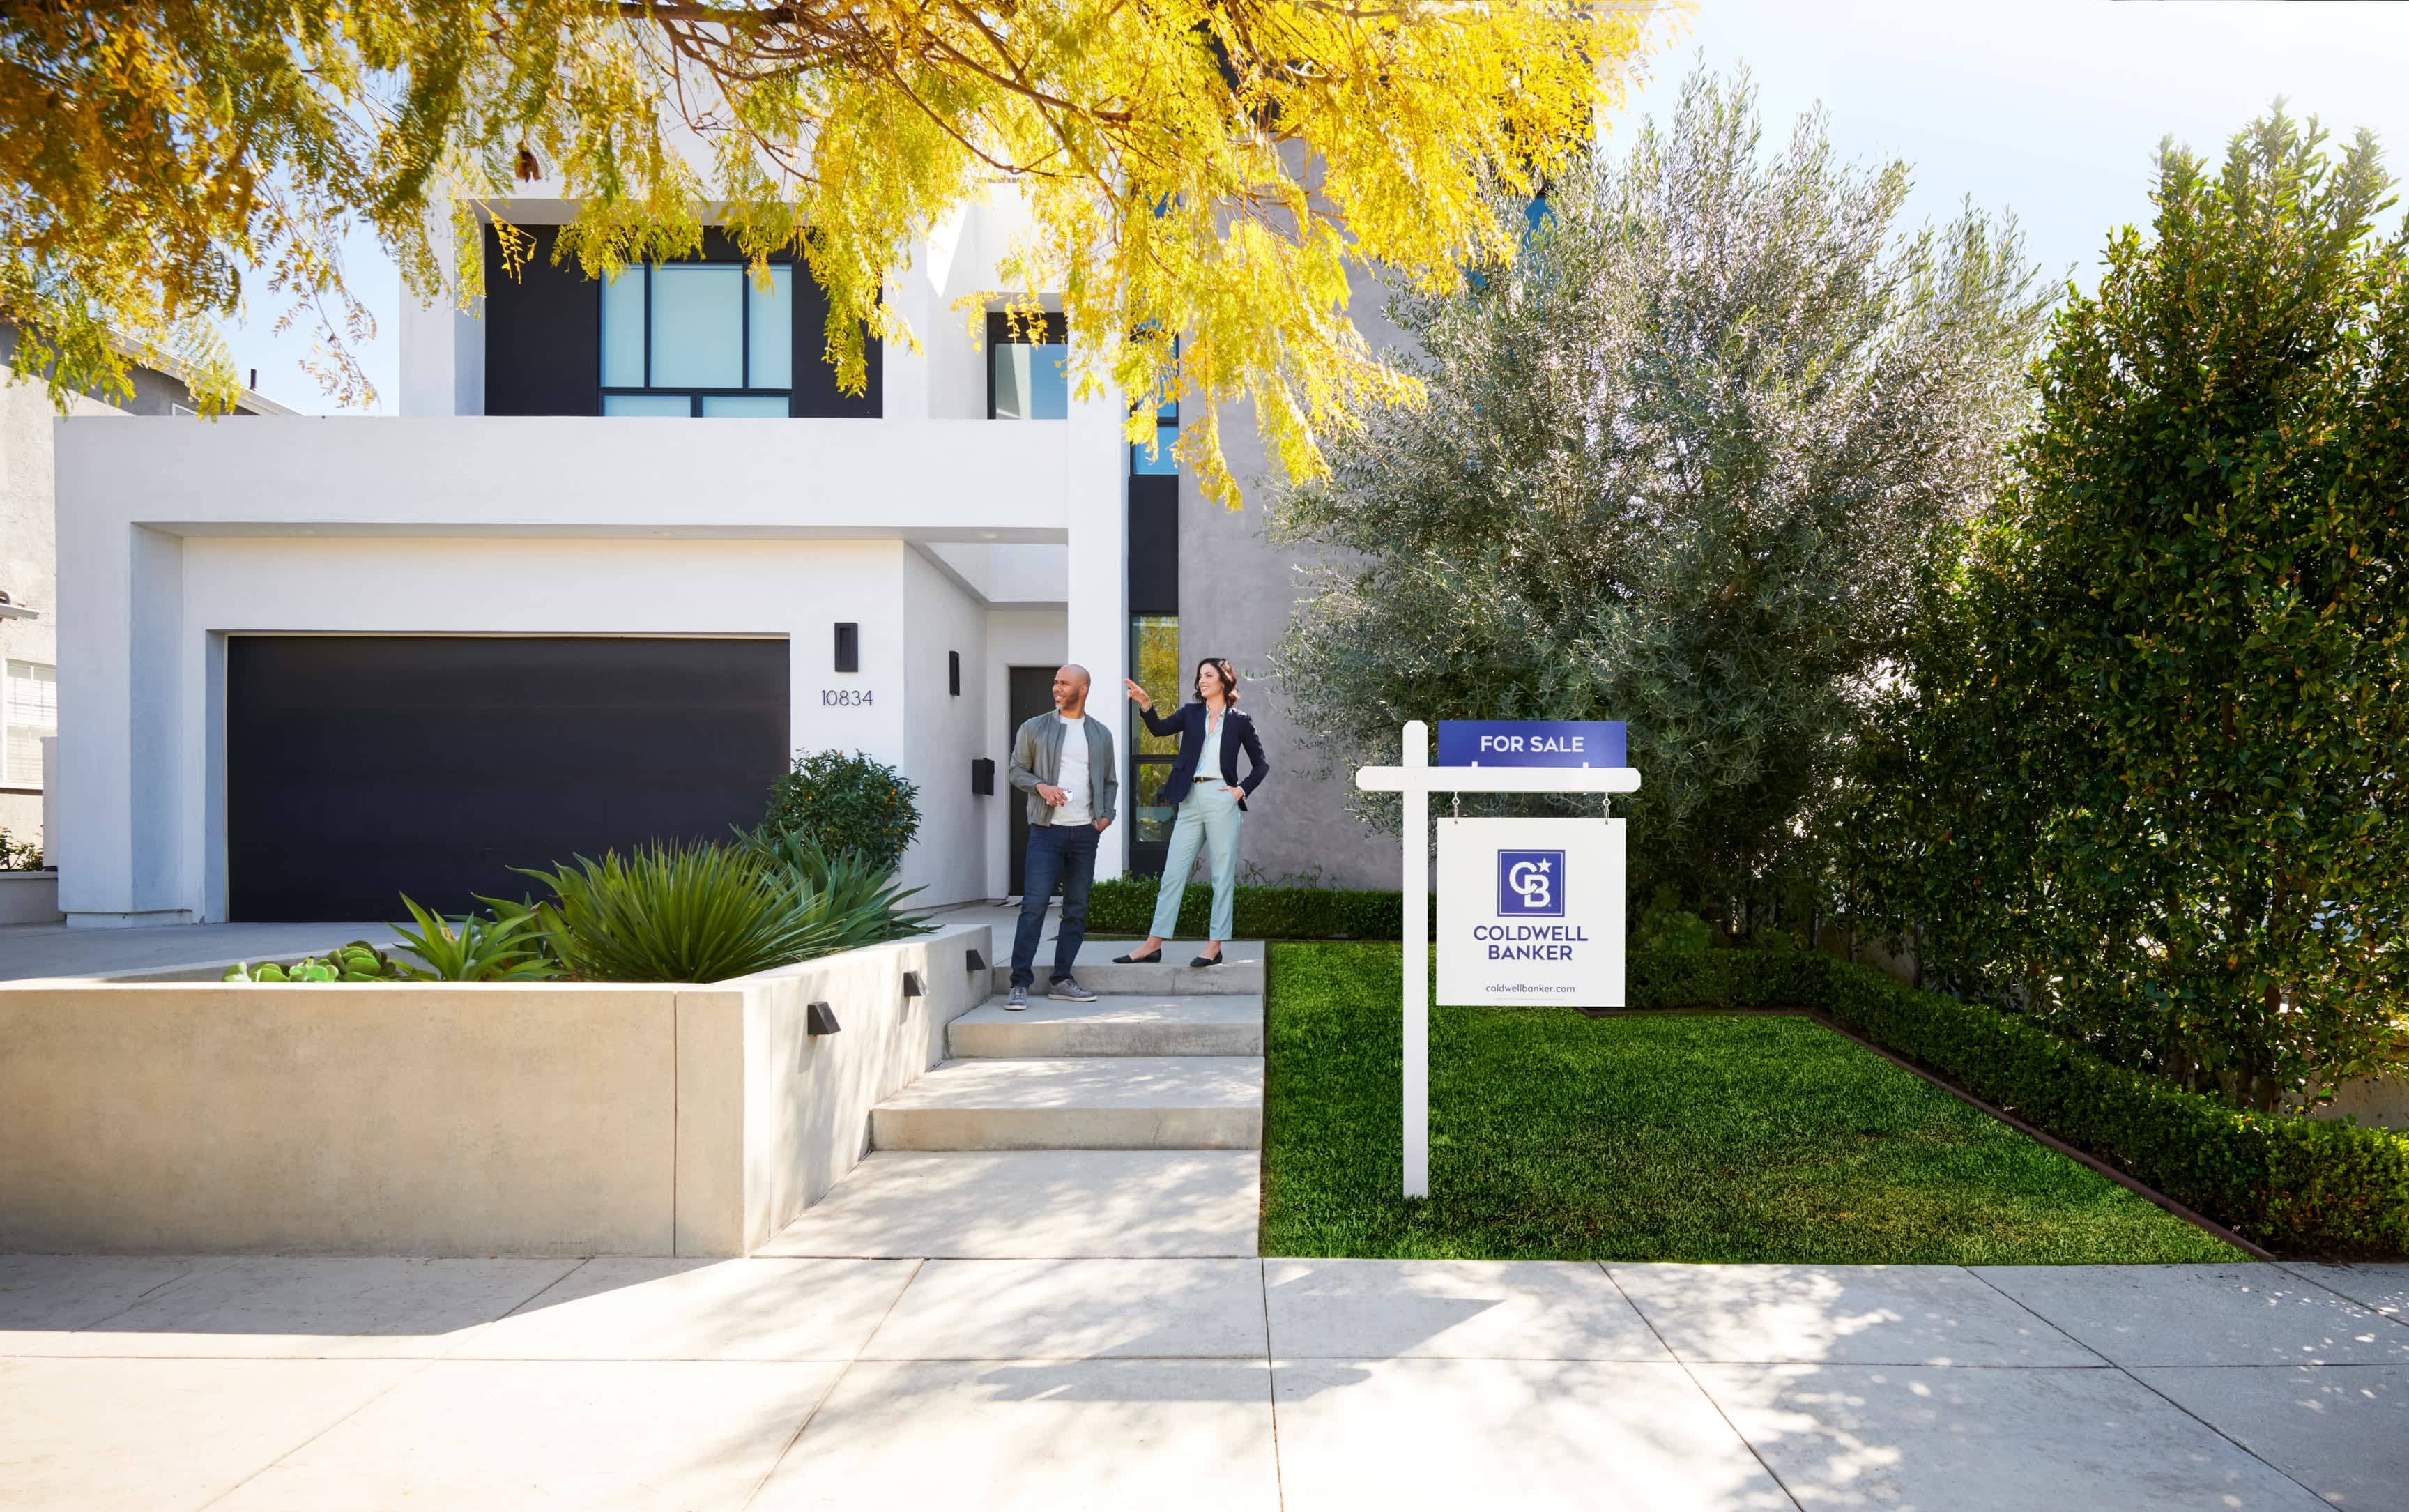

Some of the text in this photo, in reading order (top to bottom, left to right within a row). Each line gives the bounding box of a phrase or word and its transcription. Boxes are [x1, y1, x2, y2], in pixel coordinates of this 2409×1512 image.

[821, 689, 873, 706] 10834
[1481, 735, 1584, 753] FOR SALE
[1508, 861, 1550, 908] CB
[1473, 925, 1589, 942] COLDWELL
[1488, 944, 1573, 961] BANKER
[1485, 983, 1575, 993] coldwellbanker.com
